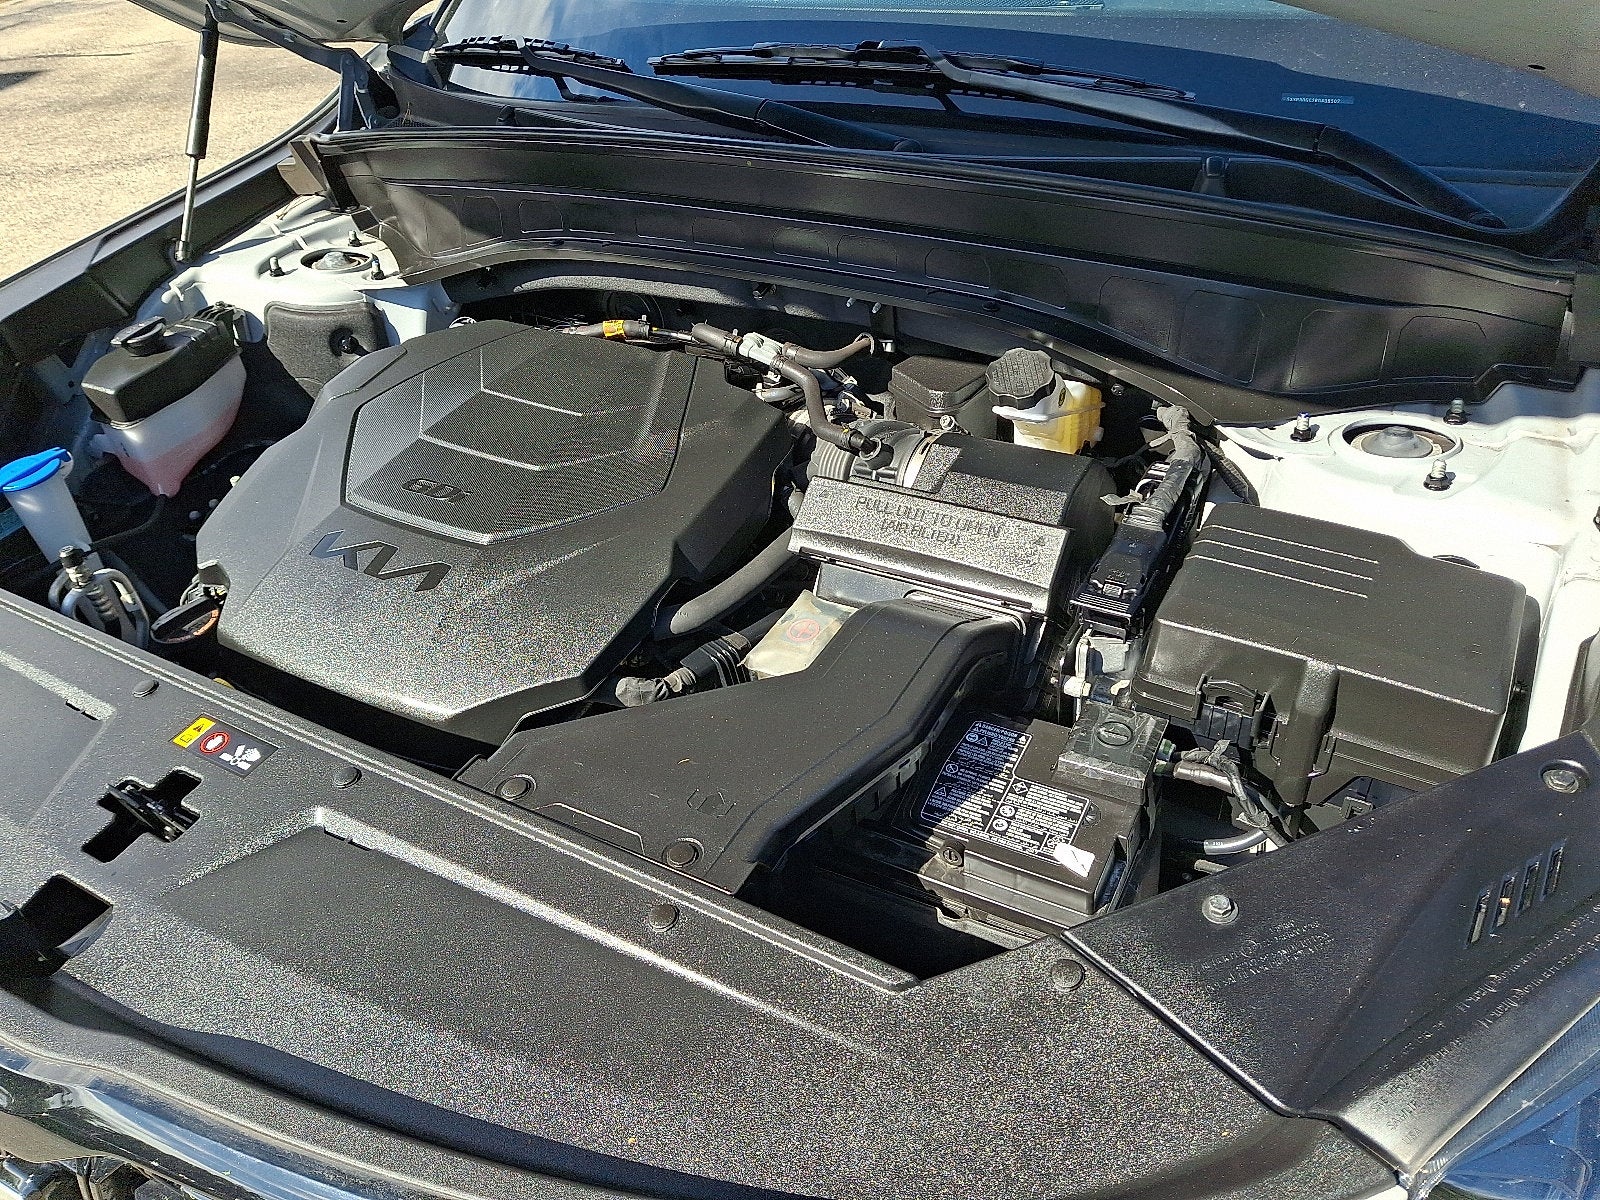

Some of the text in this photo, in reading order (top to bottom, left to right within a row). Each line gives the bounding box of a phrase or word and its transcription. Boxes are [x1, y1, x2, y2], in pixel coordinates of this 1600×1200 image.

[855, 495, 892, 515] PULL
[896, 505, 925, 522] OUT
[955, 517, 1002, 538] OPEN
